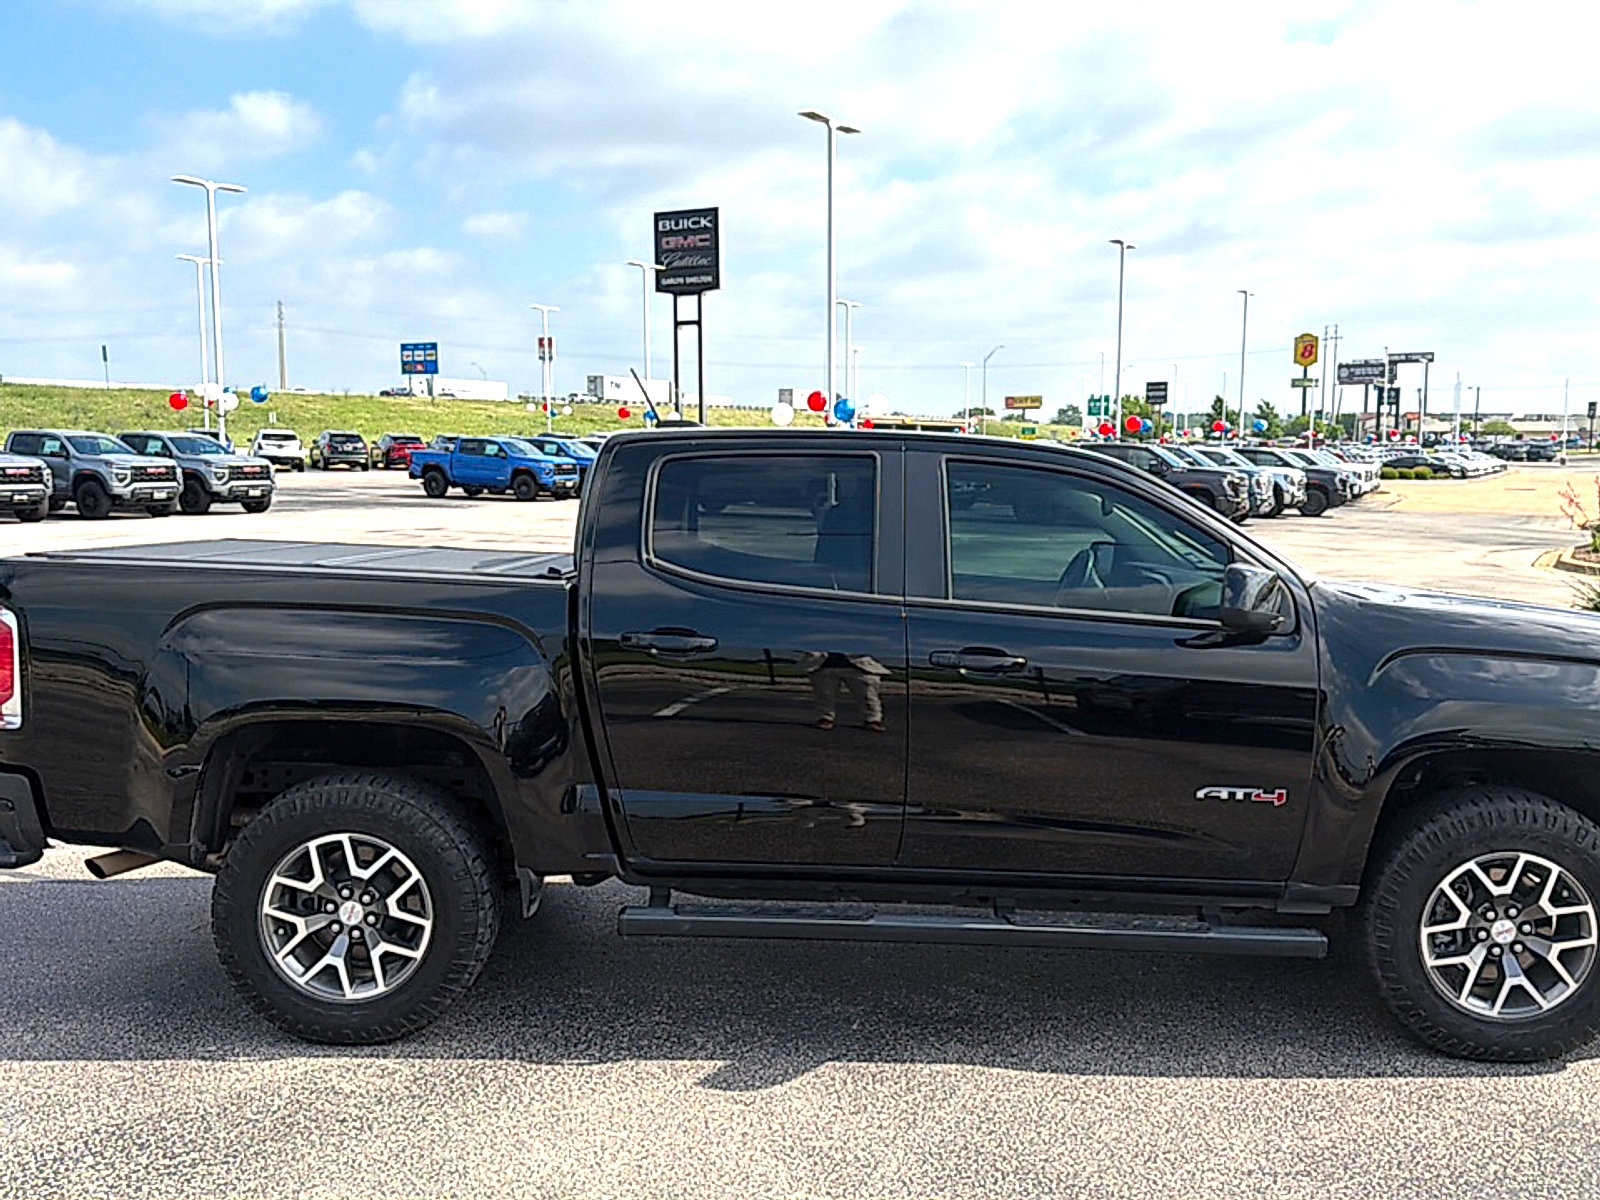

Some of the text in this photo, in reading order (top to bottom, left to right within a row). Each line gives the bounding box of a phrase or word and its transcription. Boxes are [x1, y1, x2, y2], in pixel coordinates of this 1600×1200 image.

[658, 216, 713, 231] BUICK
[661, 234, 711, 249] GMC
[1301, 343, 1314, 359] 8
[1195, 786, 1287, 807] AT4
